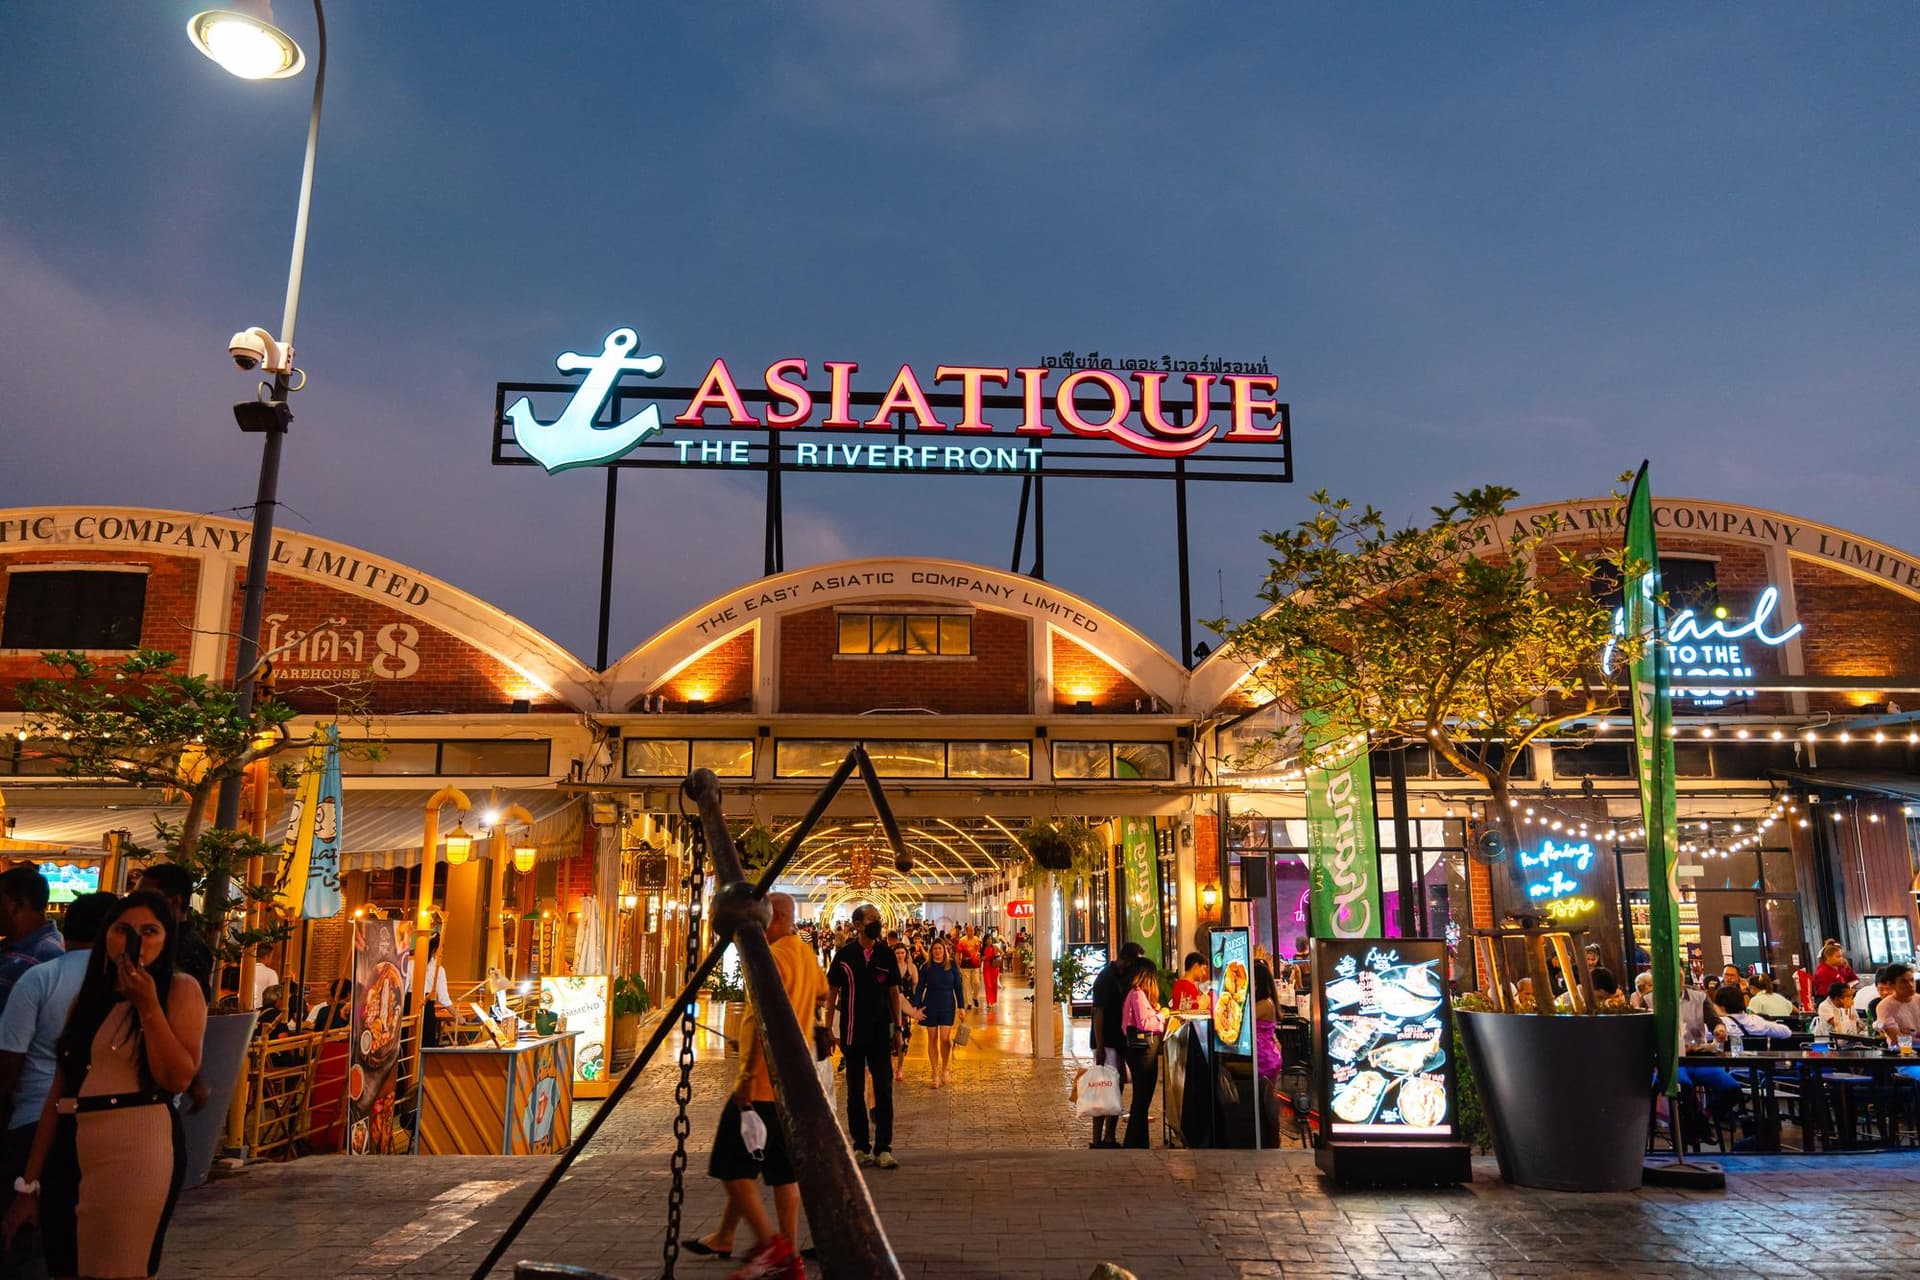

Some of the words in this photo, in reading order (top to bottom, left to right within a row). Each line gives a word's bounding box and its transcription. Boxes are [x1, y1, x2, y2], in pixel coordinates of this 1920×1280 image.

[674, 357, 1283, 458] ASIATIQUE
[673, 440, 750, 464] THE
[797, 442, 1043, 471] RIVERFRONT
[1653, 507, 1800, 545] COMPANY
[74, 516, 250, 553] COMPANY
[271, 540, 430, 607] LIMITED
[696, 607, 737, 634] THE
[744, 585, 800, 611] EAST
[812, 572, 894, 593] ASIATIC
[911, 572, 1015, 600] COMPANY
[1023, 592, 1098, 633] LIMITED
[265, 613, 364, 662] โกดัง
[372, 623, 420, 679] 8
[1666, 645, 1697, 664] TO
[1701, 645, 1741, 664] THE
